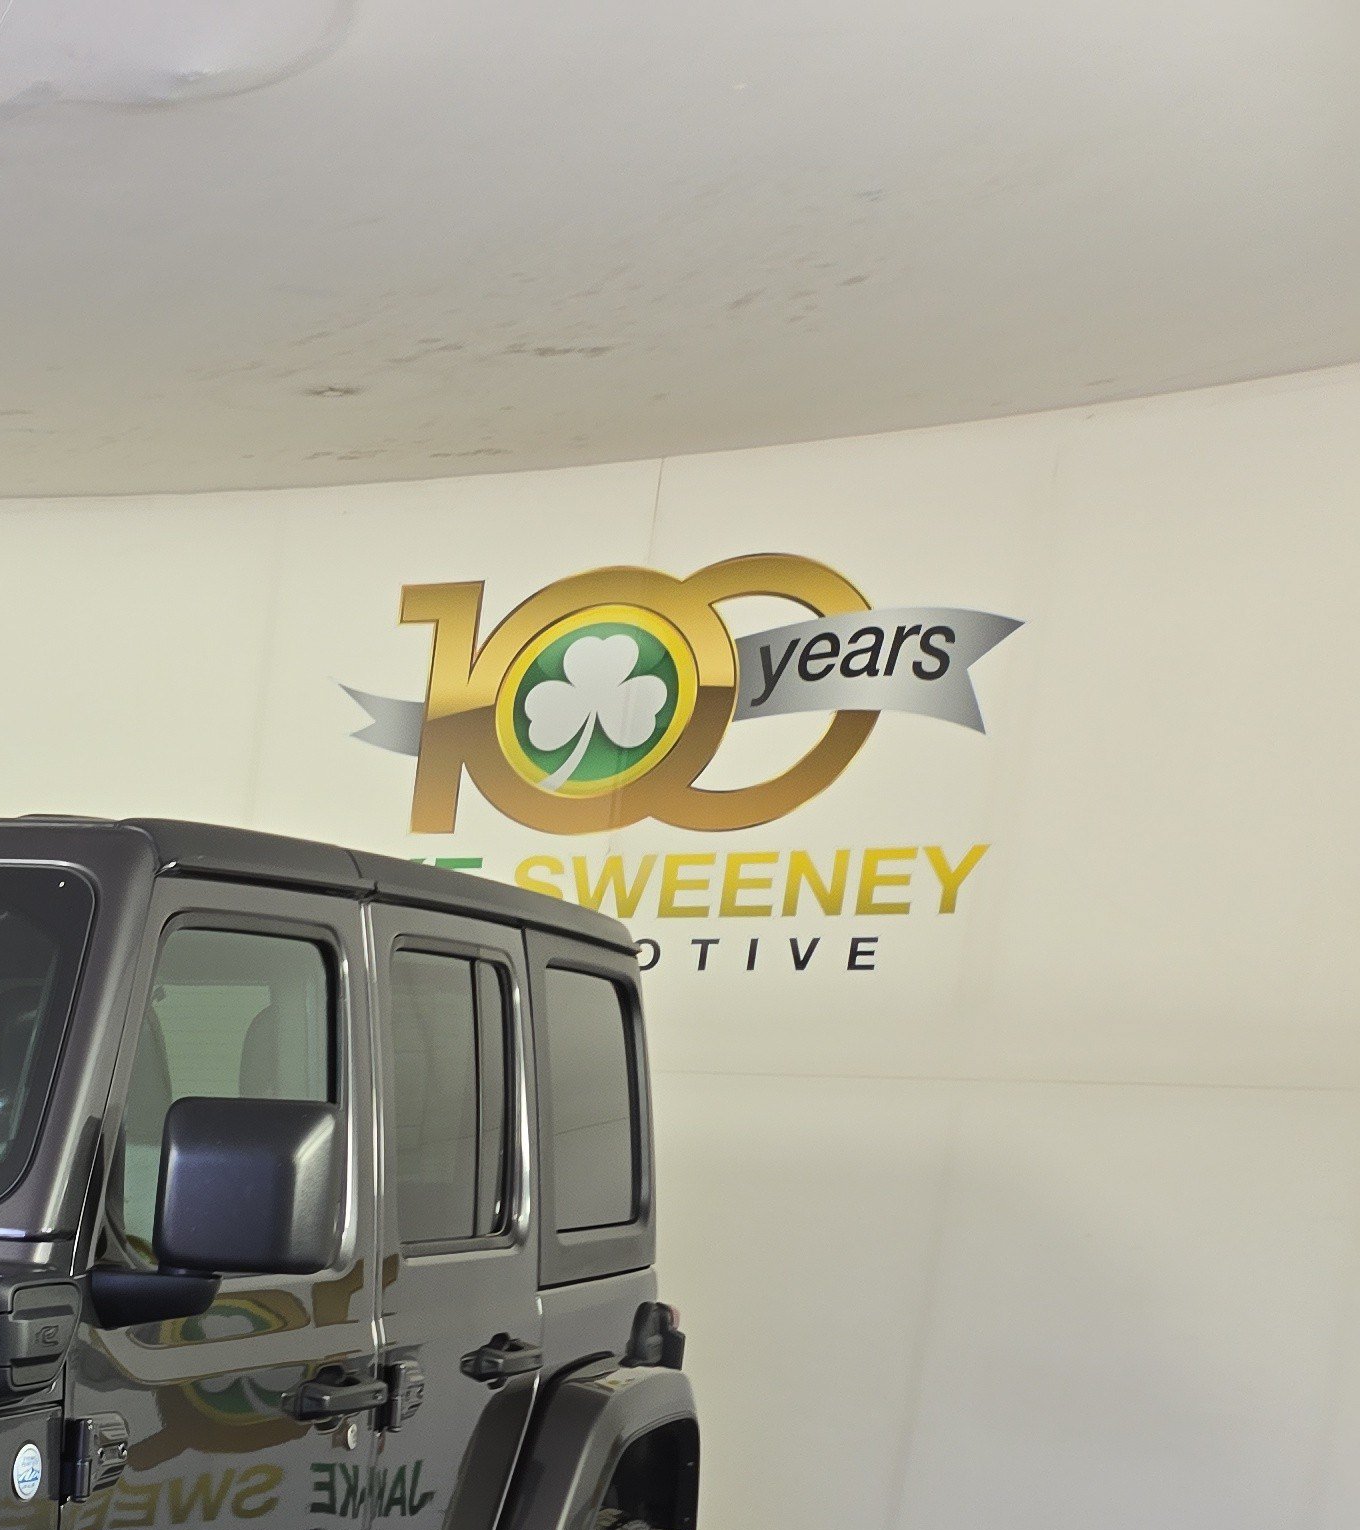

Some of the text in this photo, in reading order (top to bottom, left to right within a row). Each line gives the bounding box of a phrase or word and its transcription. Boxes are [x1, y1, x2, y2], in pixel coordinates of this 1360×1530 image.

[748, 619, 956, 707] years
[513, 843, 992, 918] SWEENEY
[632, 936, 880, 972] OTIVE
